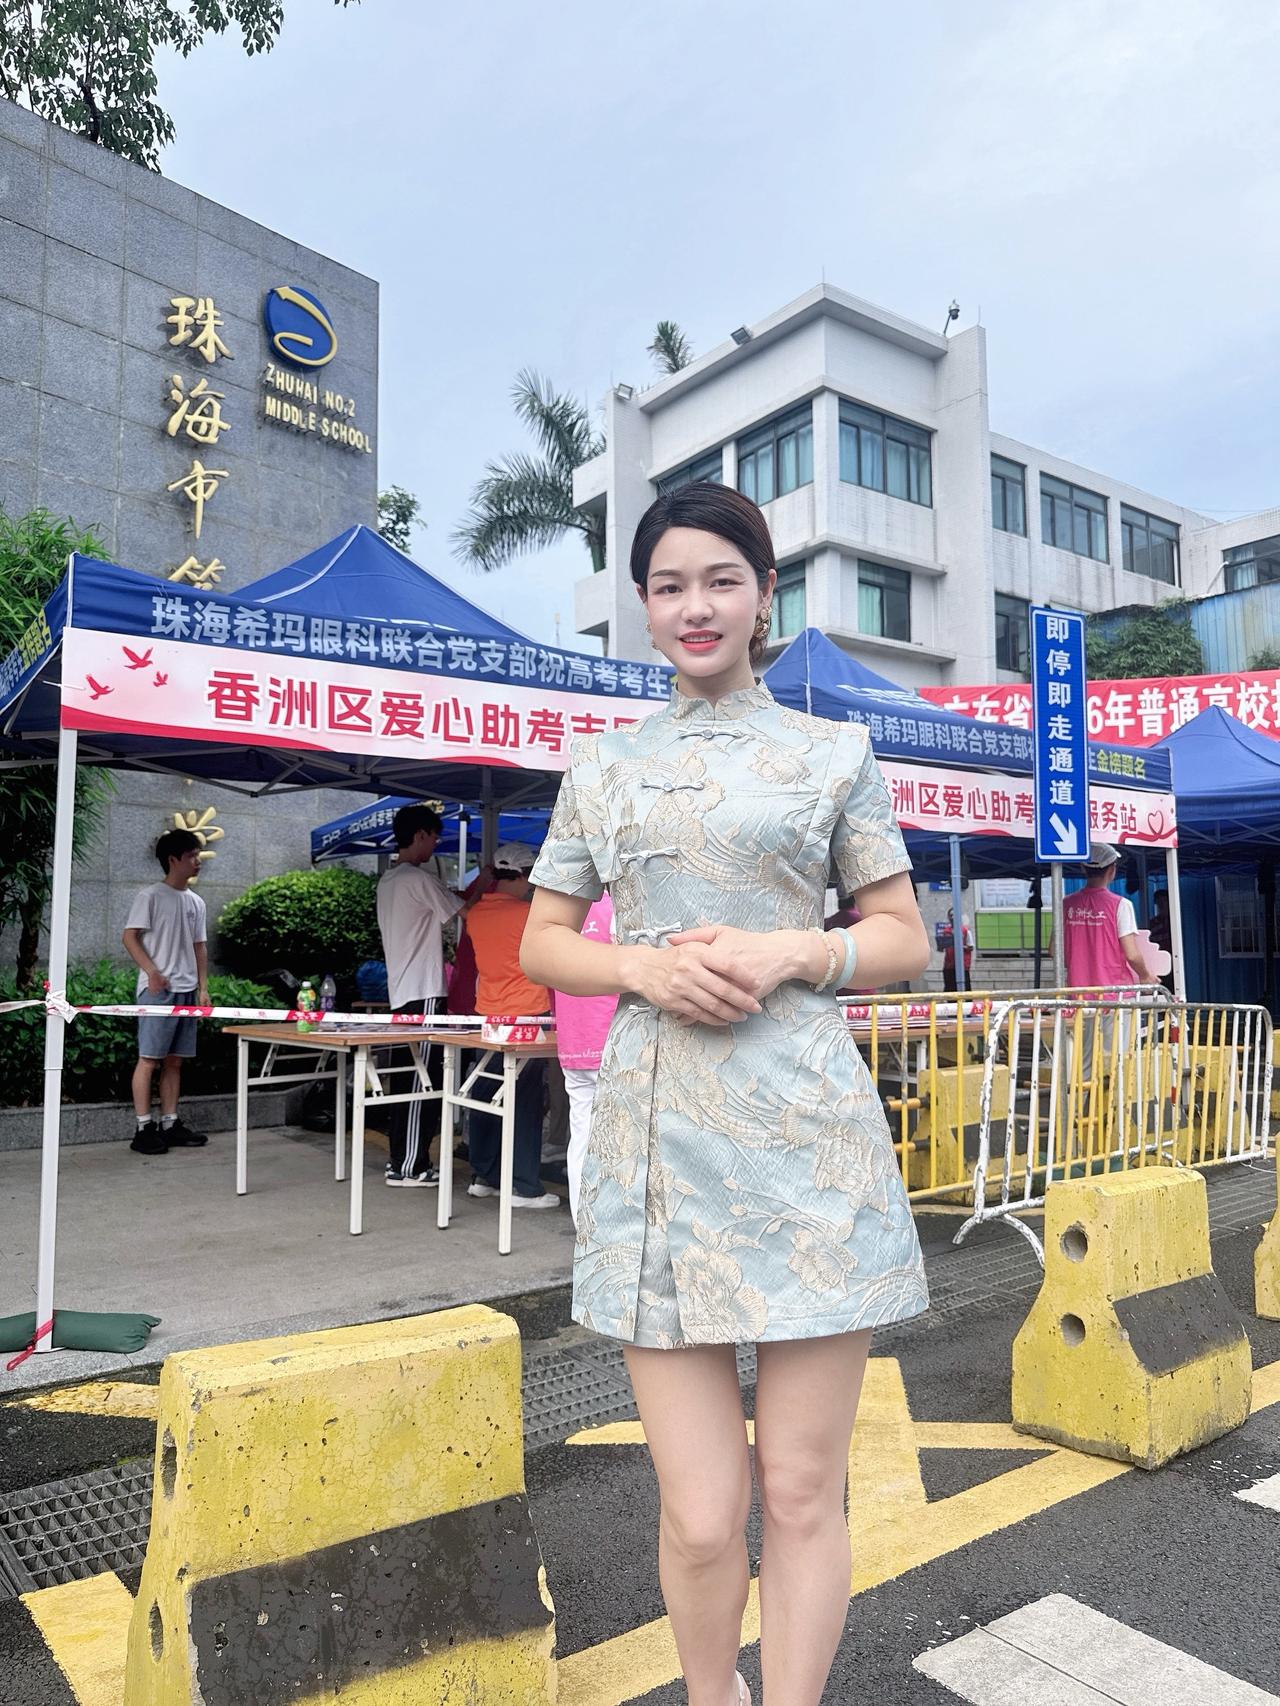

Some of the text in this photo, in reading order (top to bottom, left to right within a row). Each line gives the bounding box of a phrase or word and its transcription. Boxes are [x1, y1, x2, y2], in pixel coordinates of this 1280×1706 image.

[264, 362, 356, 417] ZHUHAI NO.2
[265, 396, 372, 454] MIDDLE SCHOOL
[151, 596, 676, 699] 珠海希玛眼科联合党支部祝高考考生
[207, 671, 640, 753] 香洲区爱心助考
[847, 710, 1034, 761] 海希玛眼科联合党支部
[1046, 616, 1075, 806] 即停即走通道
[1087, 680, 1280, 738] 6年普通高校
[883, 777, 1034, 824] 洲区爱心助考
